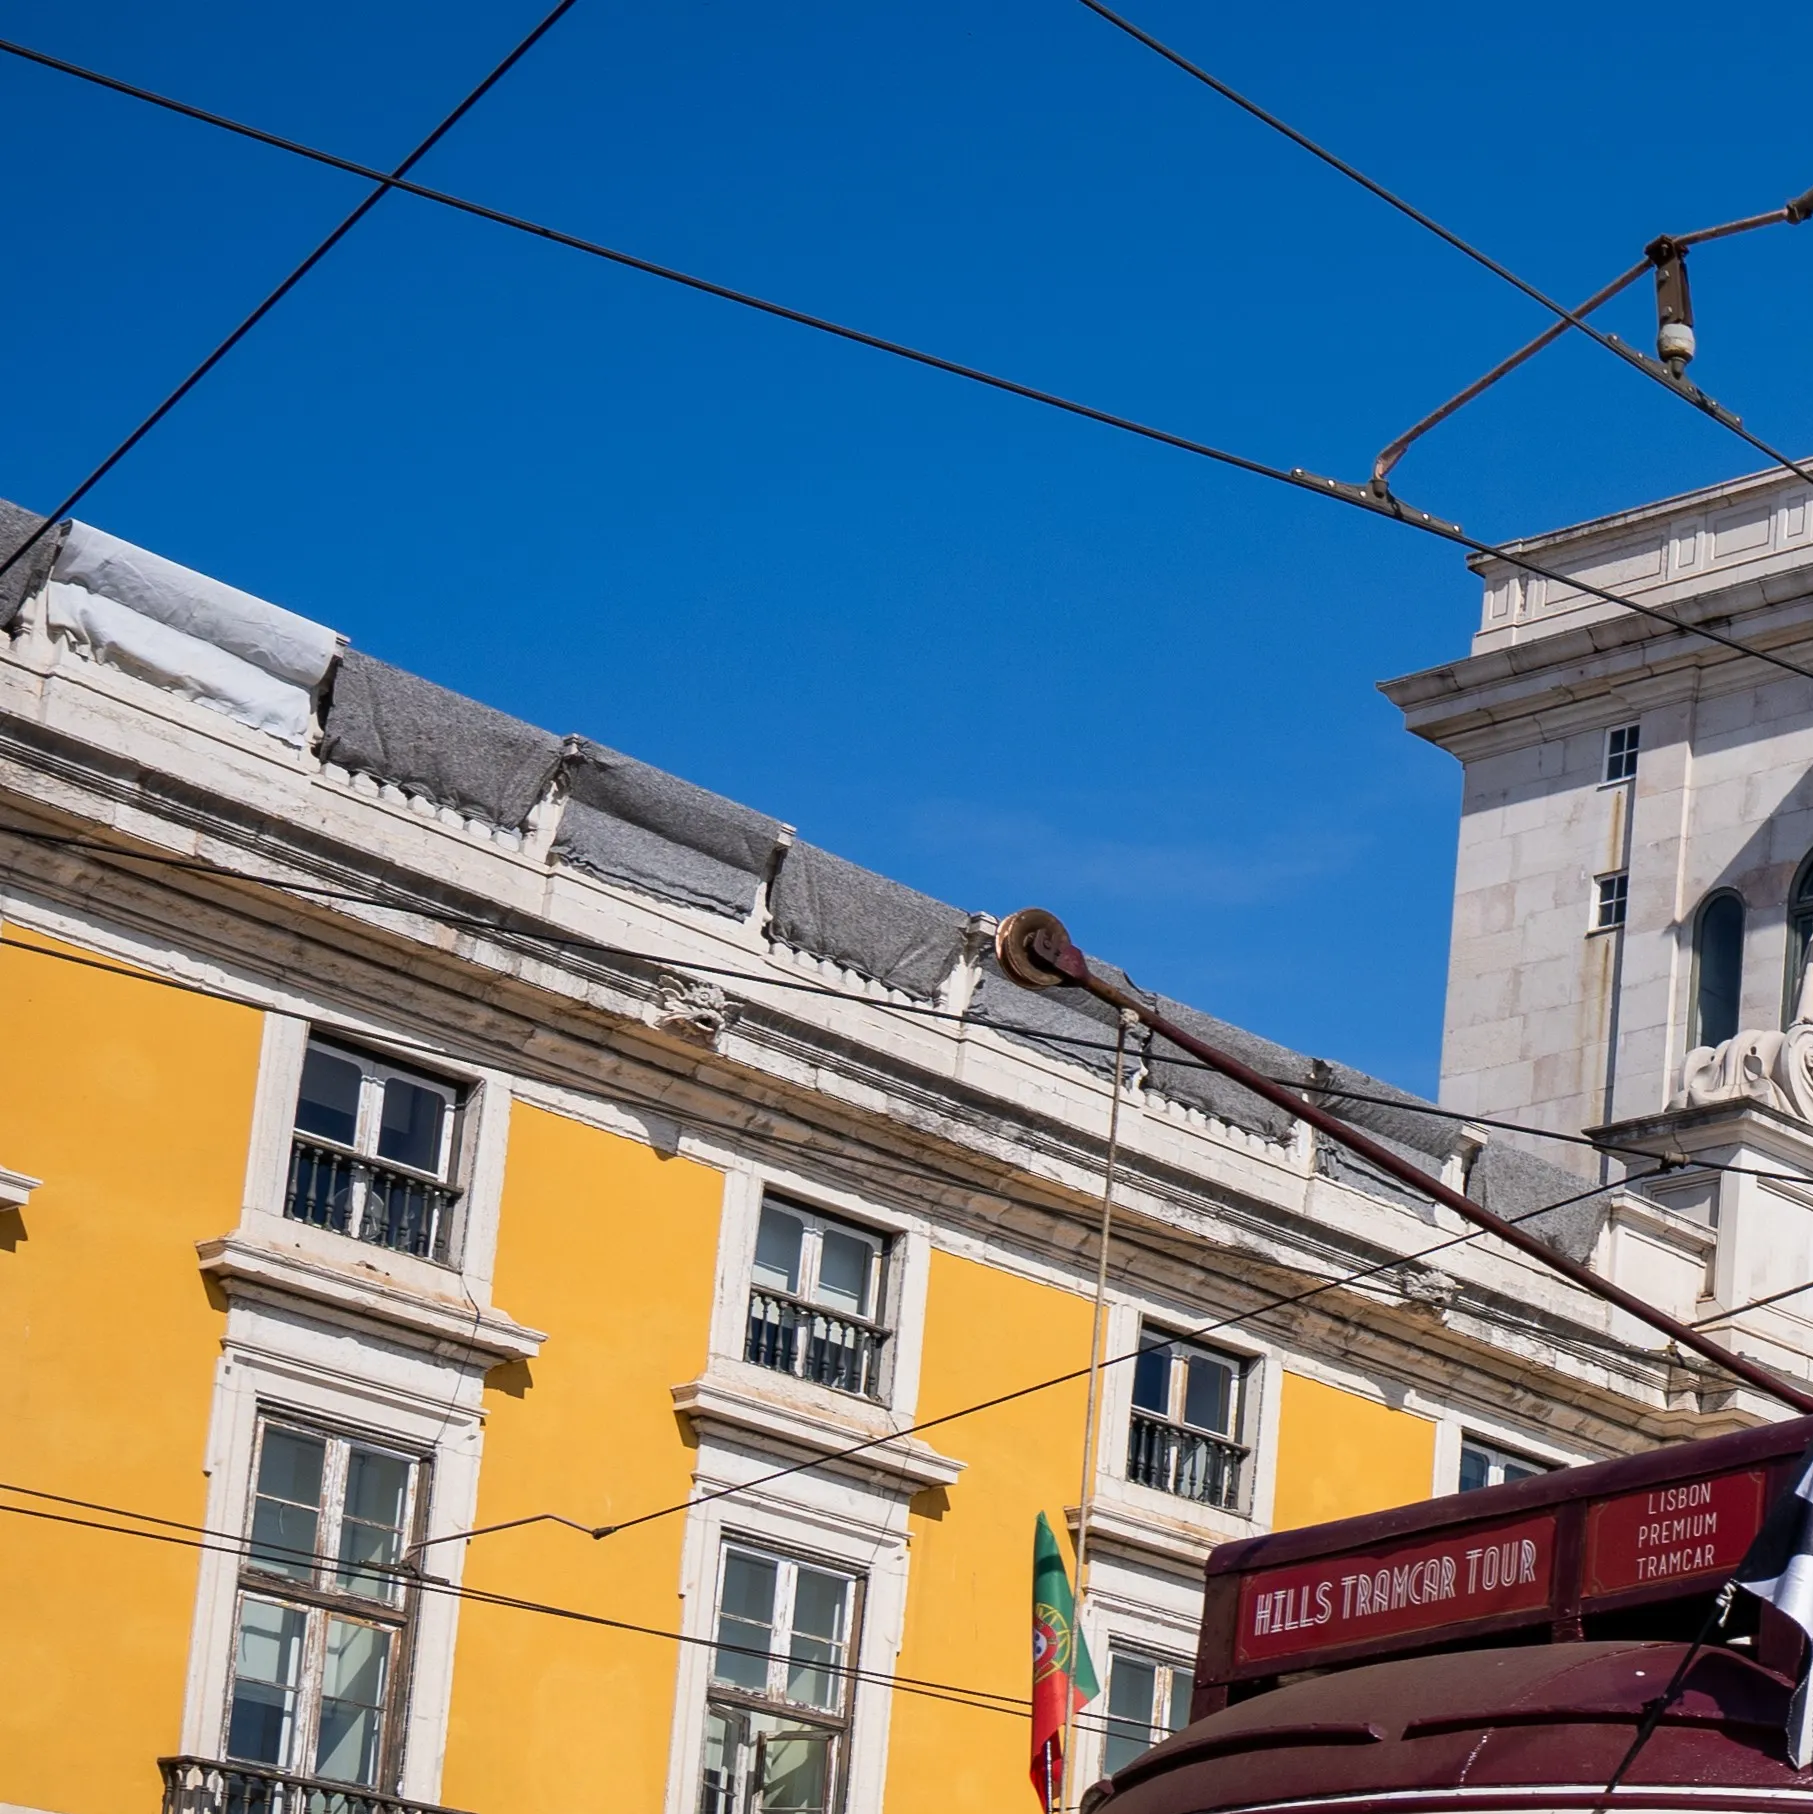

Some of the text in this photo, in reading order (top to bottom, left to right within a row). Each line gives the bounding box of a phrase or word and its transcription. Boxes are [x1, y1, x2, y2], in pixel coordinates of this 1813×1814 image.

[1648, 1482, 1712, 1515] LISBON
[1638, 1512, 1718, 1549] PREMIUM
[1636, 1546, 1715, 1581] TRAMCAR
[1254, 1539, 1537, 1636] HILLS TRAMCAR TOUR
